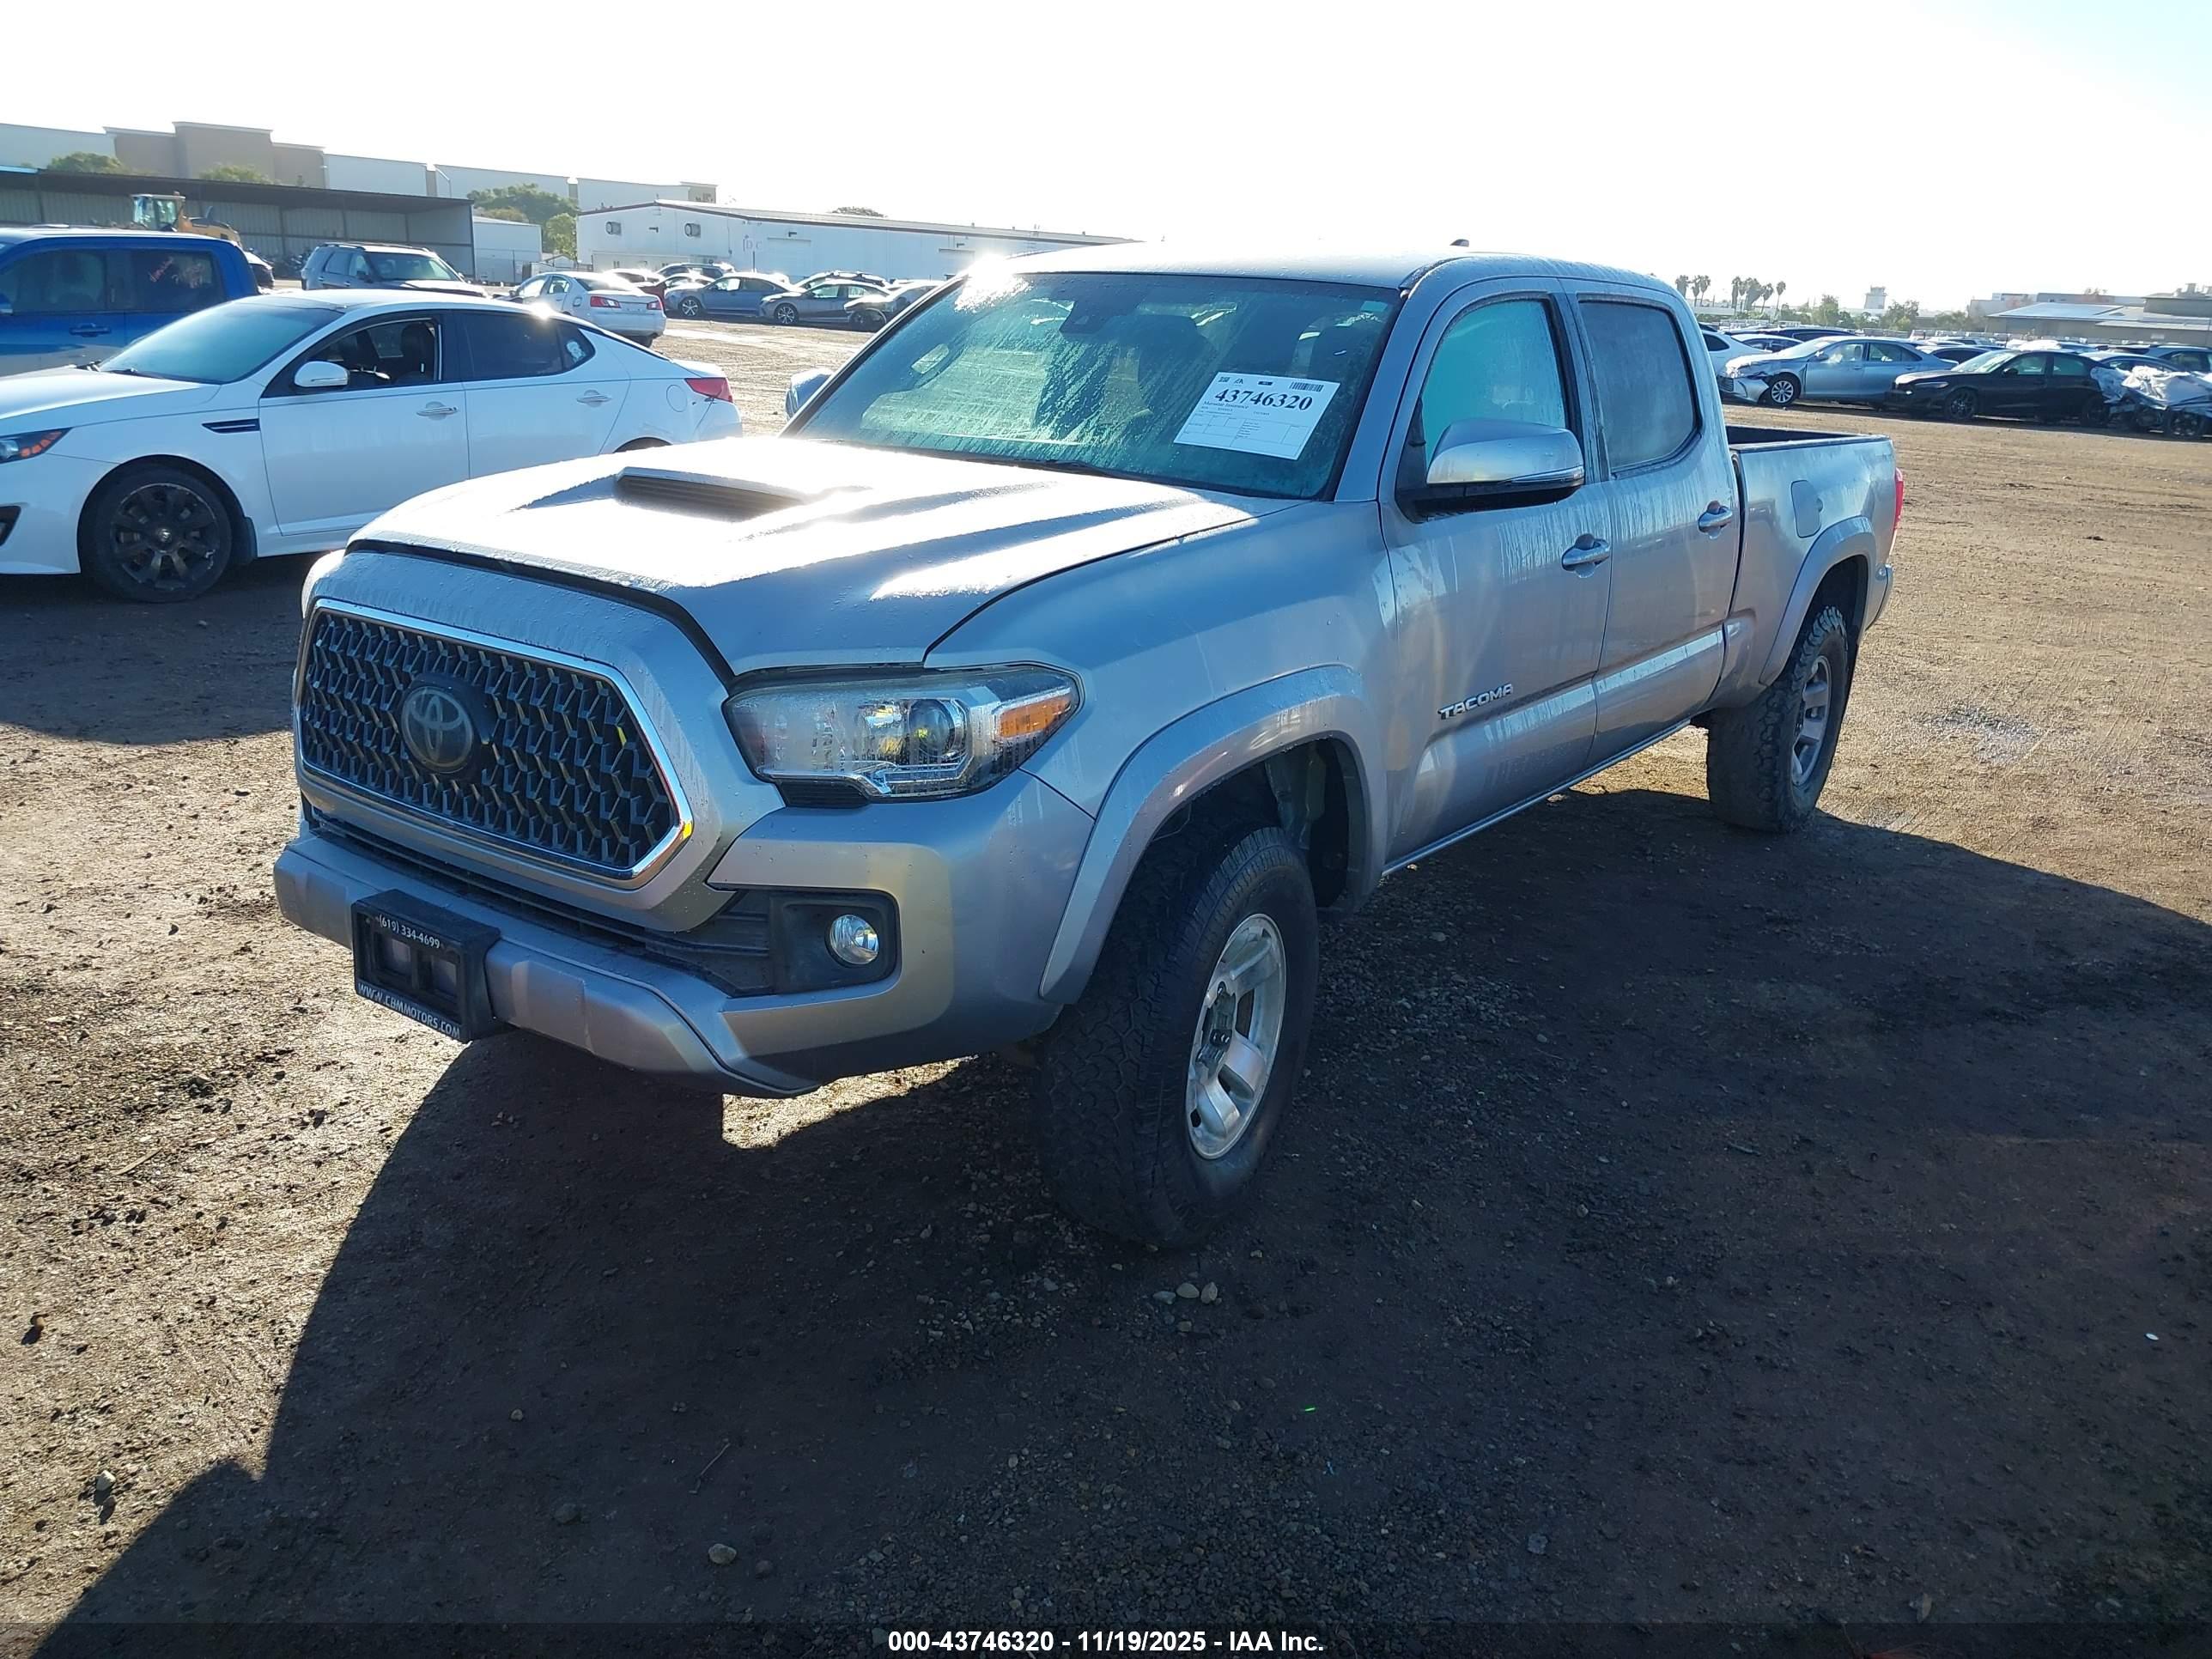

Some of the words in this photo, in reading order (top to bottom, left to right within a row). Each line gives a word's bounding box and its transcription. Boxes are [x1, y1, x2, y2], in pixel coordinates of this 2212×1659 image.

[1214, 388, 1313, 410] 43746320
[1438, 684, 1514, 720] TACOMA
[378, 914, 399, 933] (619)
[401, 924, 441, 949] 334-4699
